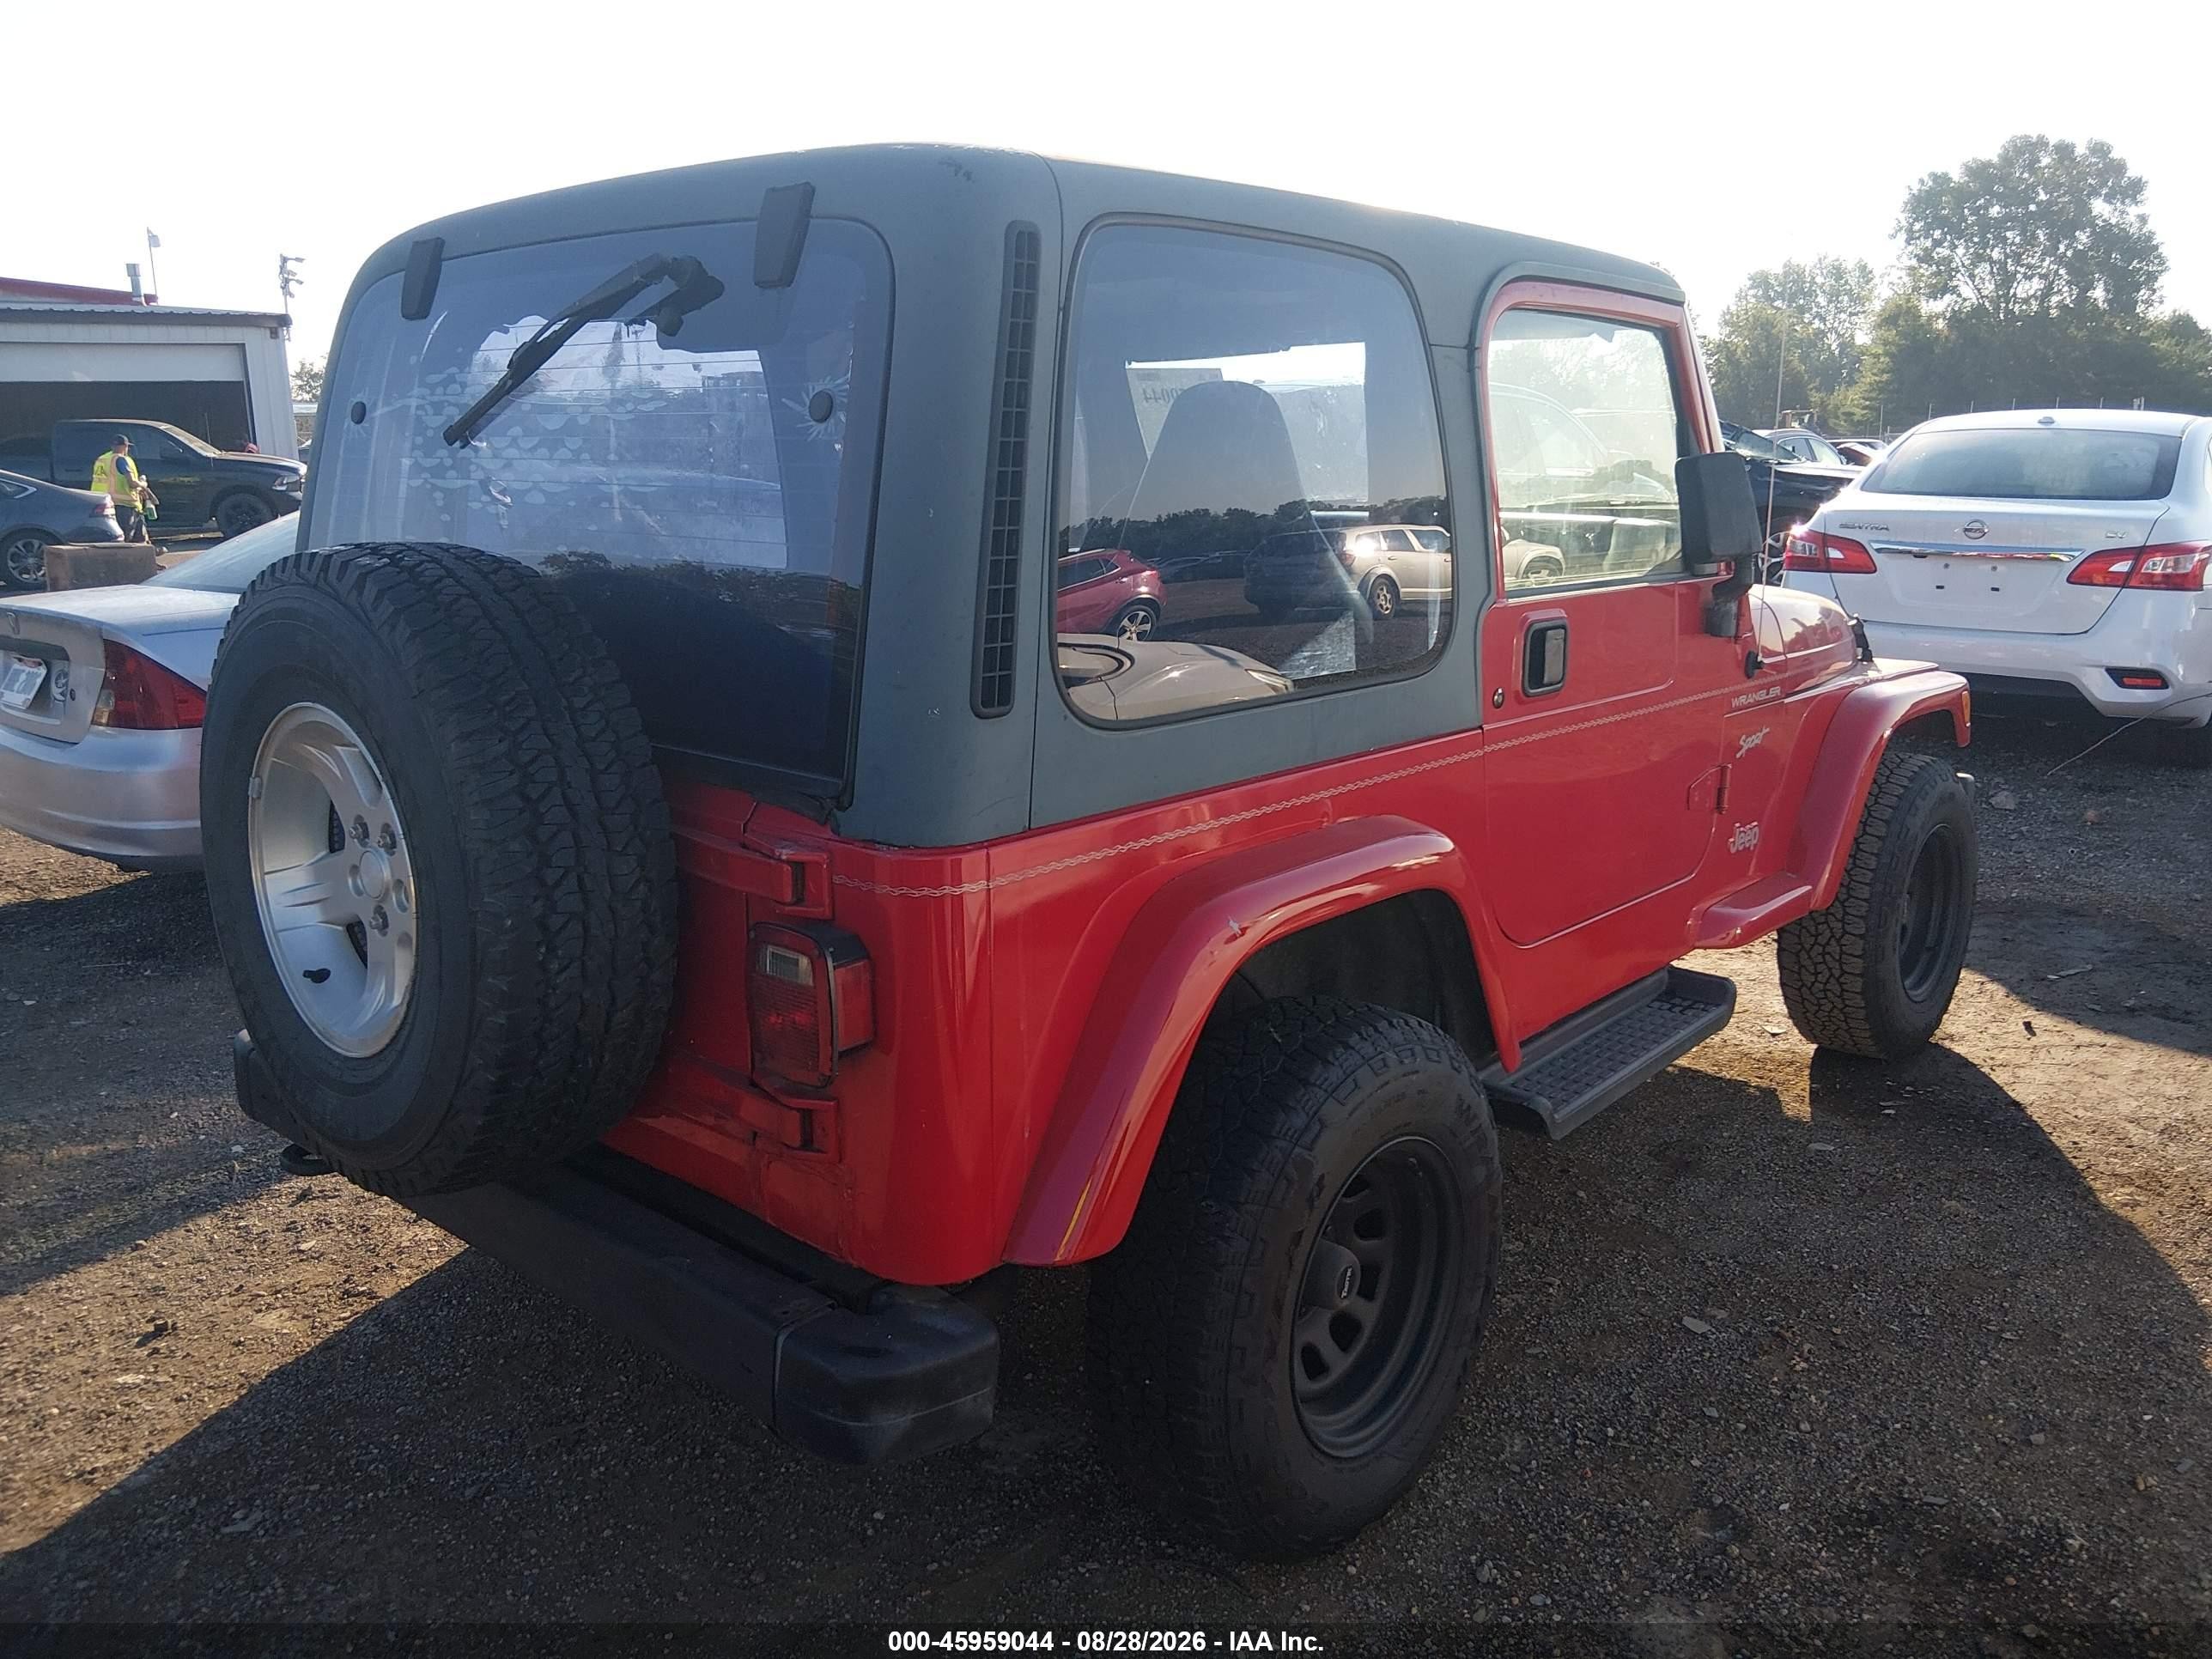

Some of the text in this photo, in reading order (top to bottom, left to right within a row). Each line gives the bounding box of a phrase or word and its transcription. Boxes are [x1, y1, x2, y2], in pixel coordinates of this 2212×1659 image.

[1731, 686, 1781, 708] WRANGLER
[1736, 725, 1771, 759] Sport
[1729, 822, 1759, 854] Jeep
